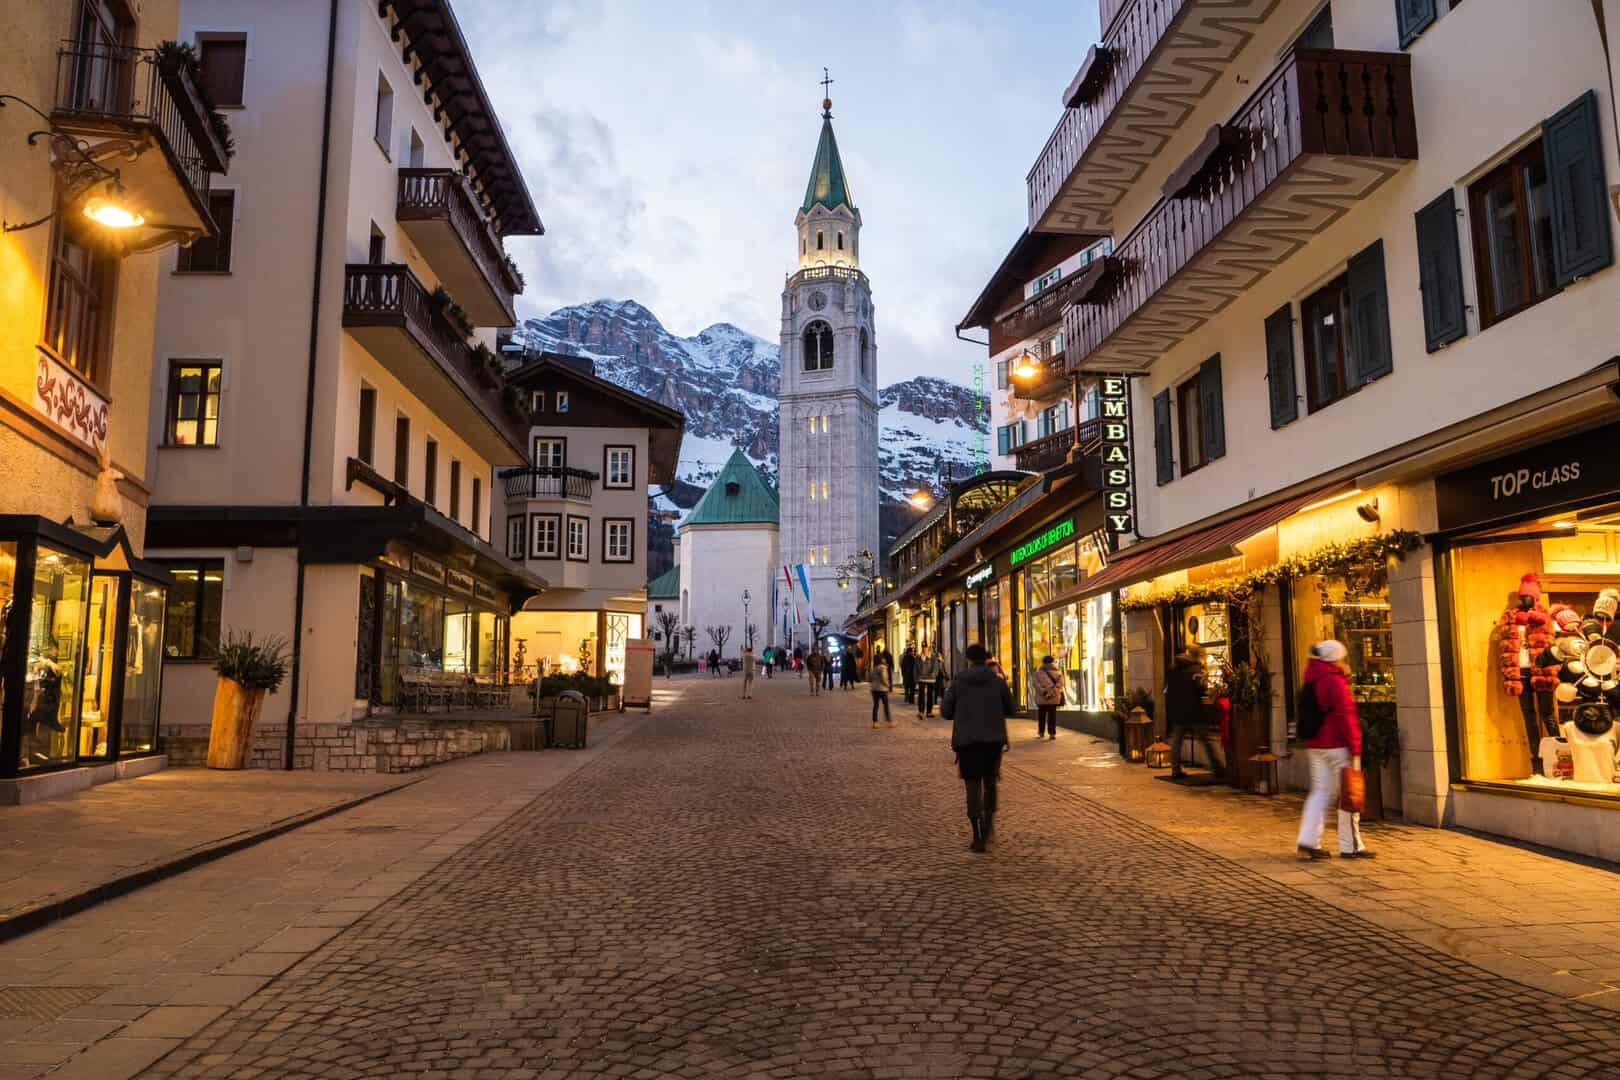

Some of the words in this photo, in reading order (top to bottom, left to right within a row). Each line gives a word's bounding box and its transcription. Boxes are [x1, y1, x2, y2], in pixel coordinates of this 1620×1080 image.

[1103, 379, 1129, 531] EMBASSY
[1491, 468, 1530, 499] TOP
[1532, 462, 1580, 489] CLASS
